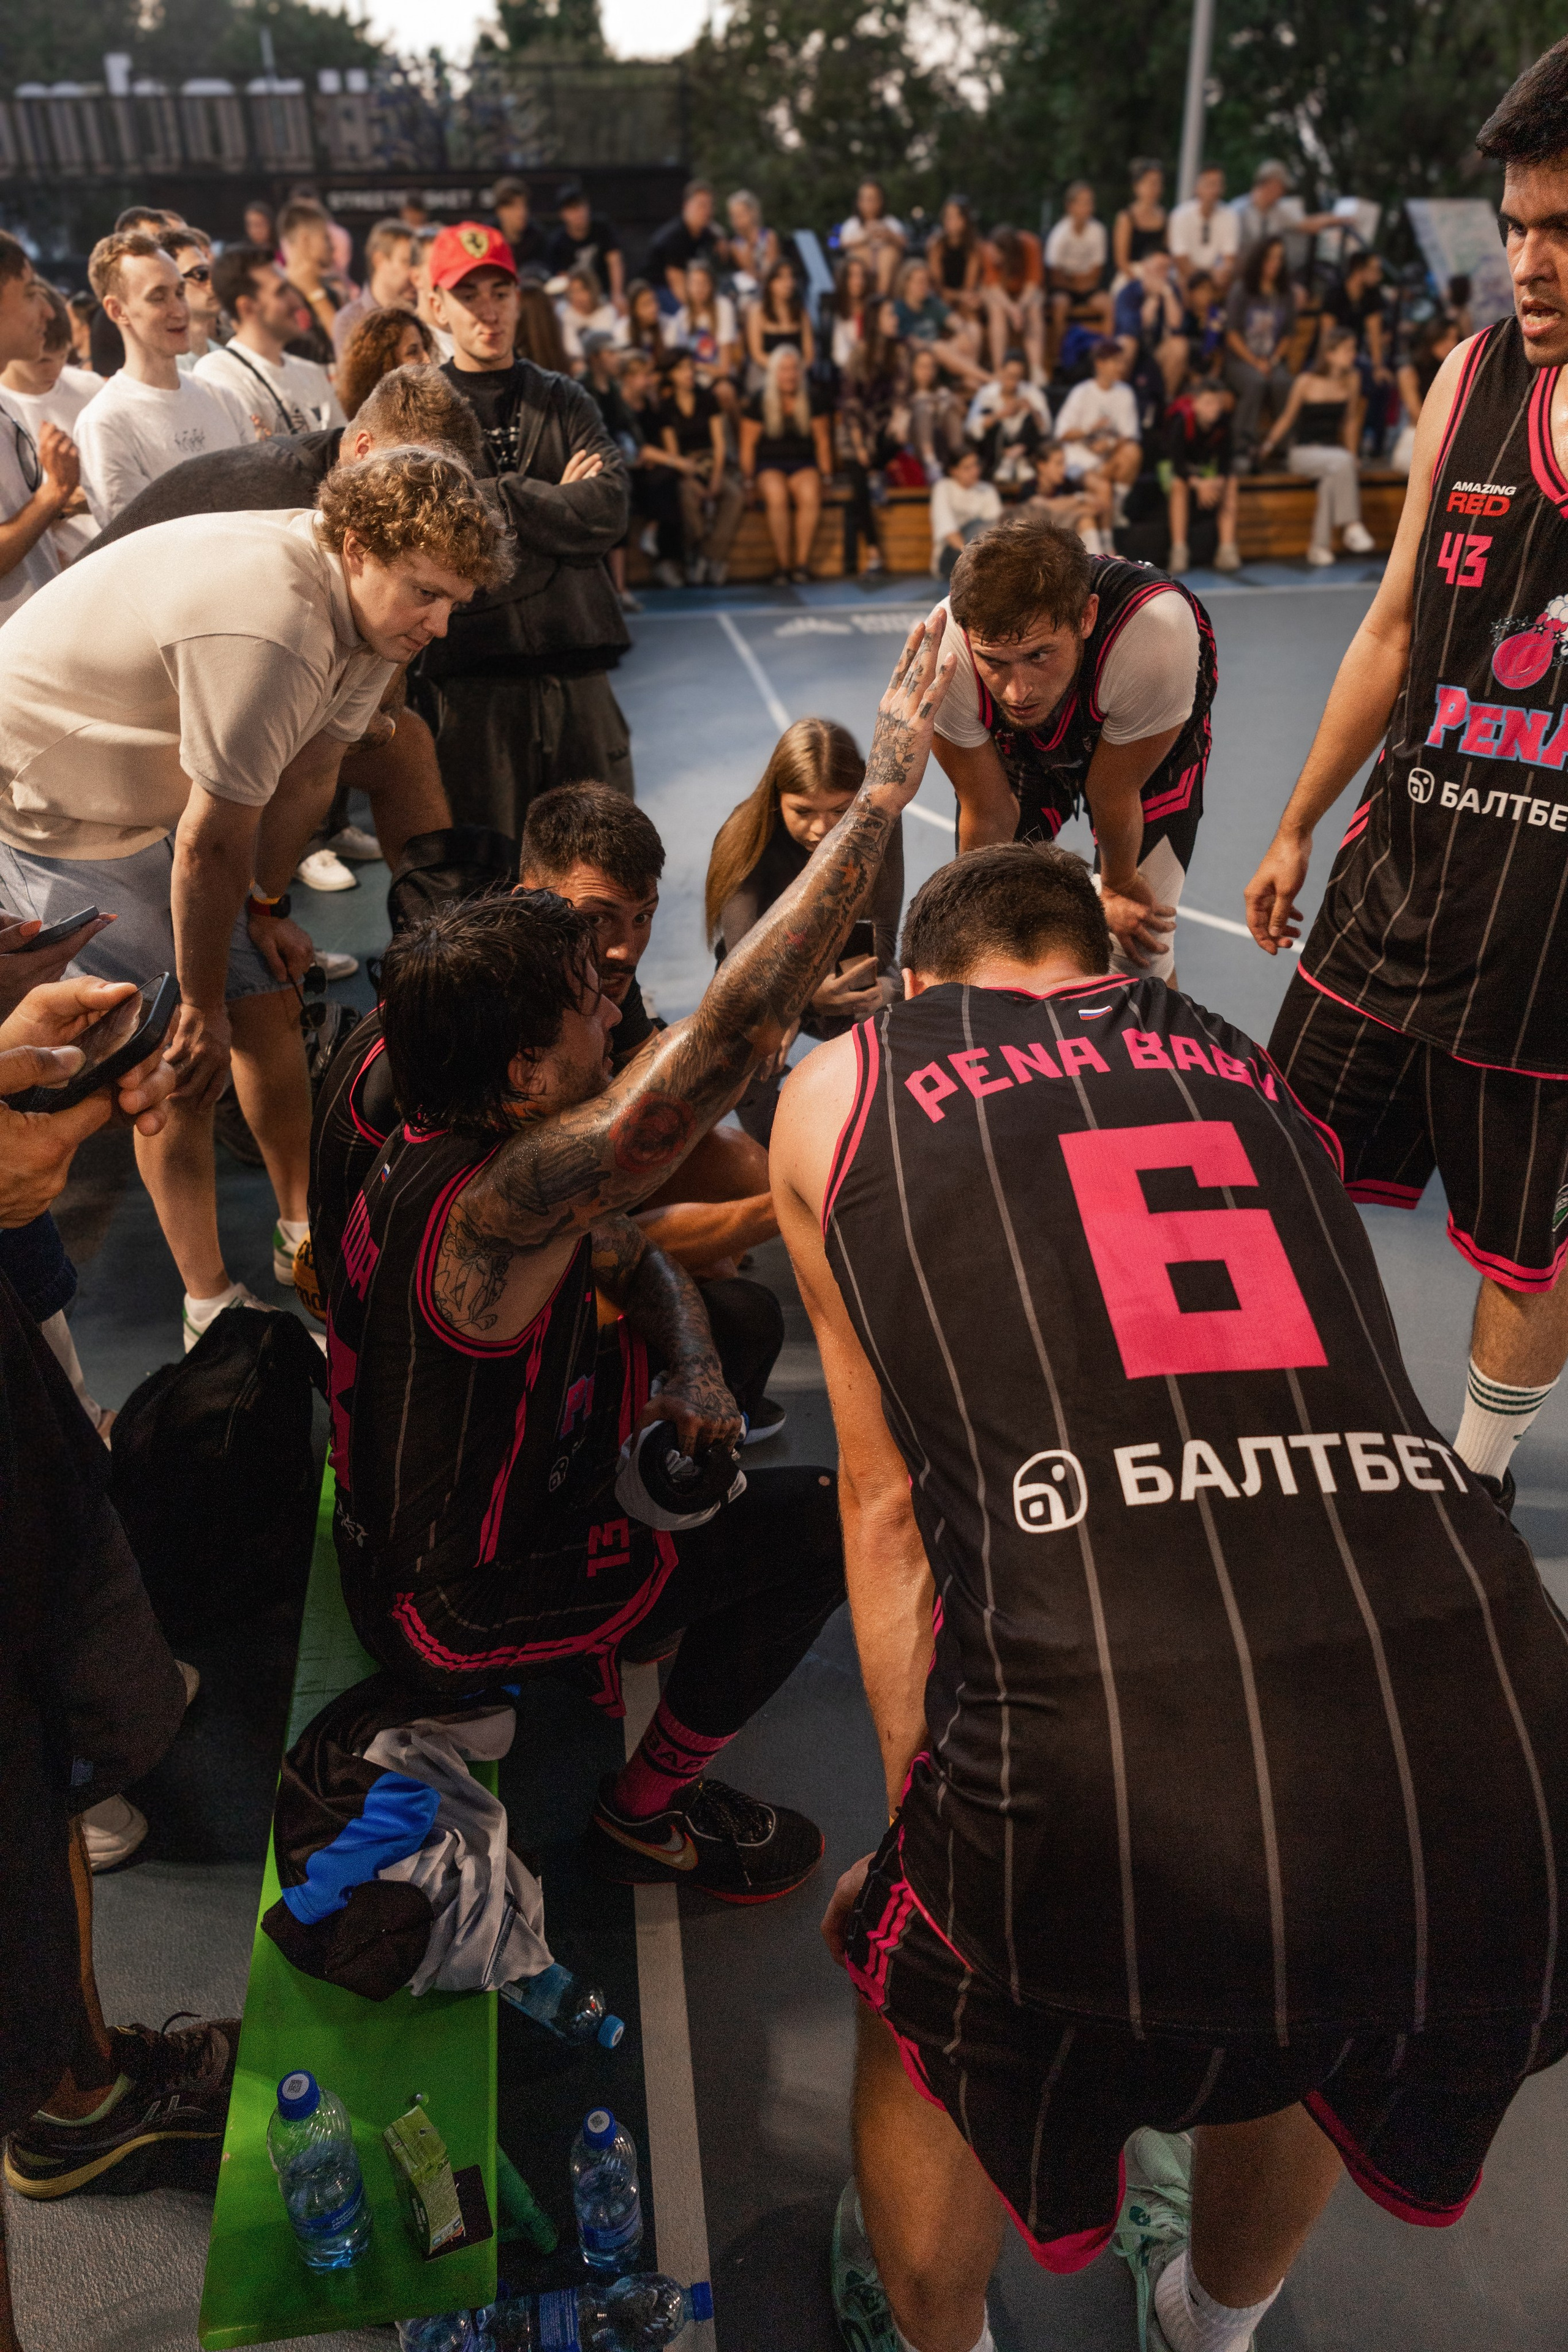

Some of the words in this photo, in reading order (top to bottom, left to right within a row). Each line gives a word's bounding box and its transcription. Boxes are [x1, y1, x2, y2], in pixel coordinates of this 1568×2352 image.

[1446, 491, 1510, 516] RED
[1452, 481, 1517, 495] AMAZING
[1437, 531, 1493, 587] 43
[904, 1037, 1111, 1123] PENA
[1058, 1120, 1328, 1380] 6
[1113, 1431, 1469, 1506] БАЛТБЕТ
